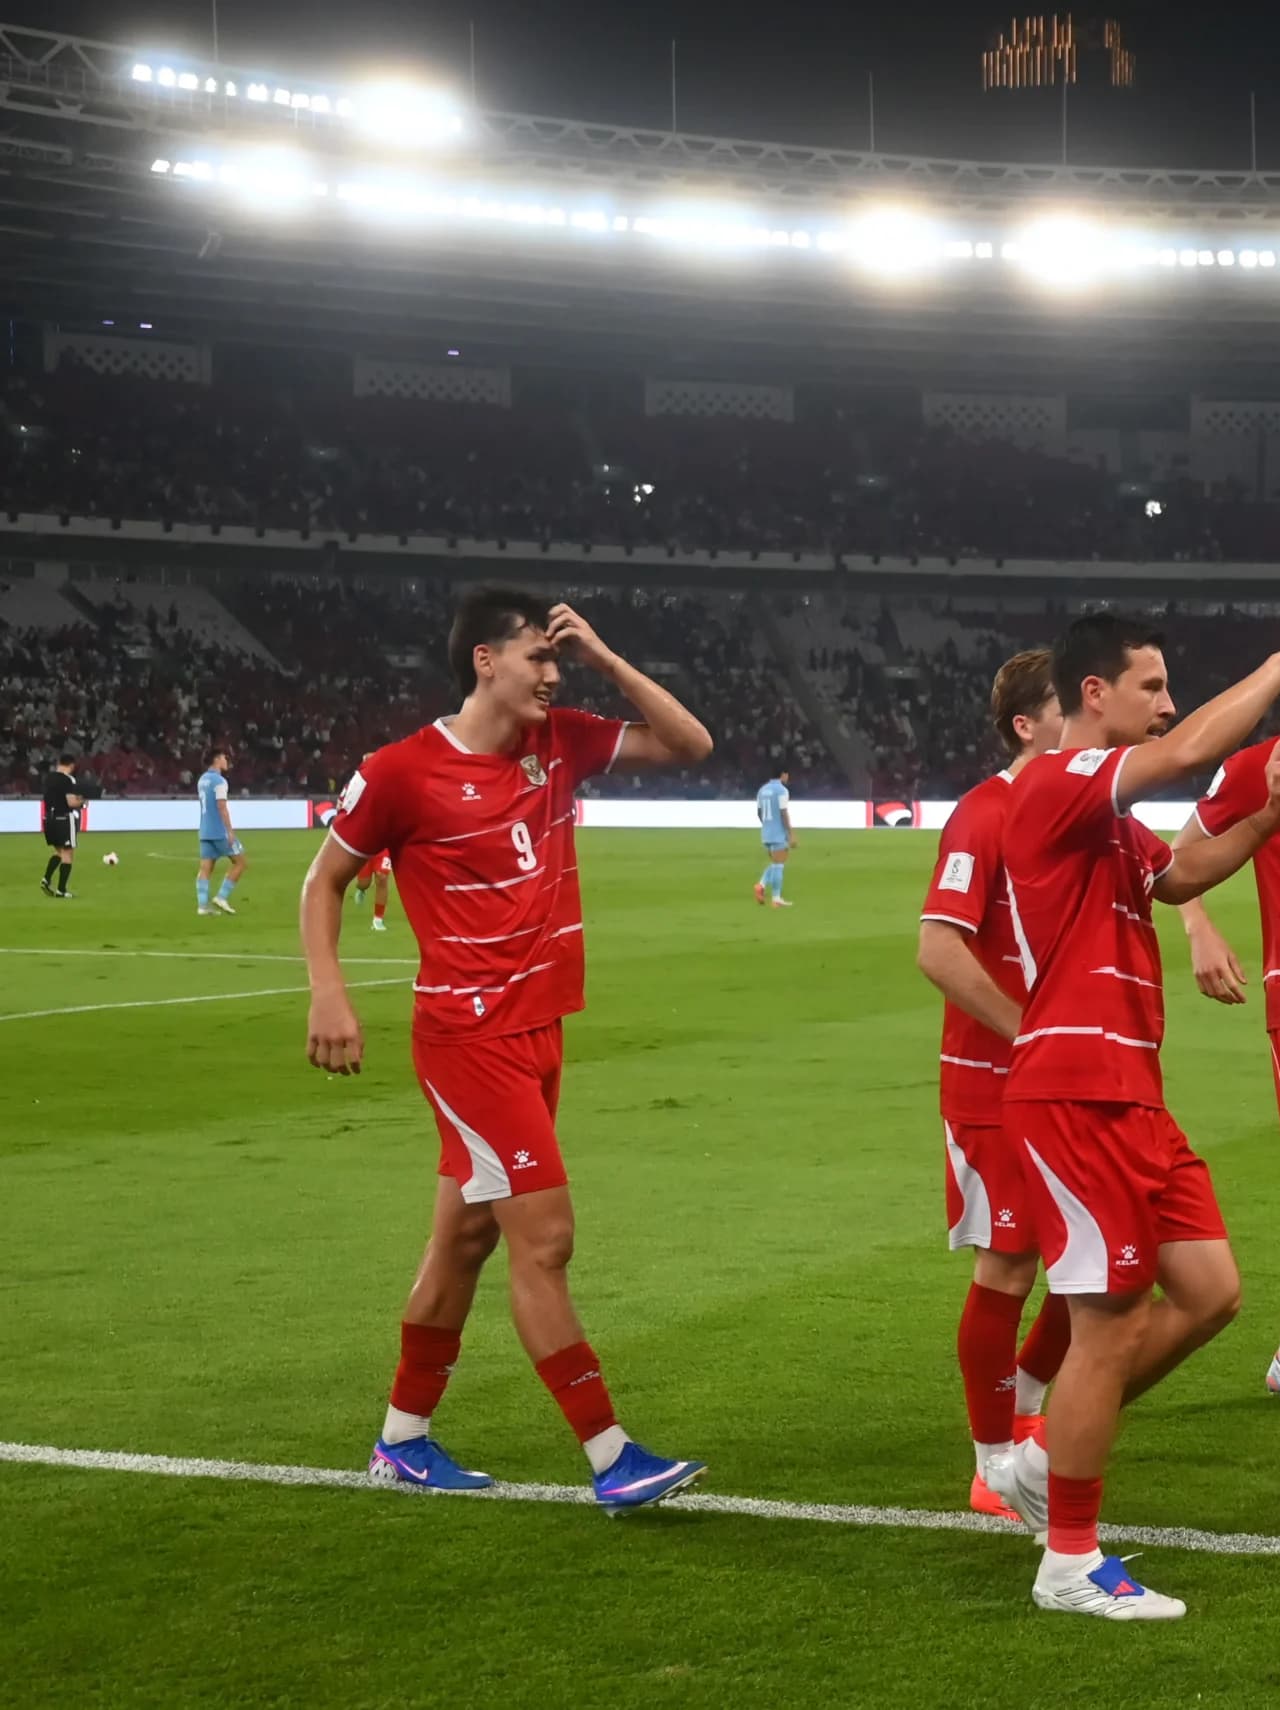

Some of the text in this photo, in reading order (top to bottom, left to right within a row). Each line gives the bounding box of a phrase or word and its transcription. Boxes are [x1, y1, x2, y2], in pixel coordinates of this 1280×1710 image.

[511, 821, 537, 871] 9
[512, 1160, 538, 1170] KELME
[1115, 1258, 1140, 1266] KELME
